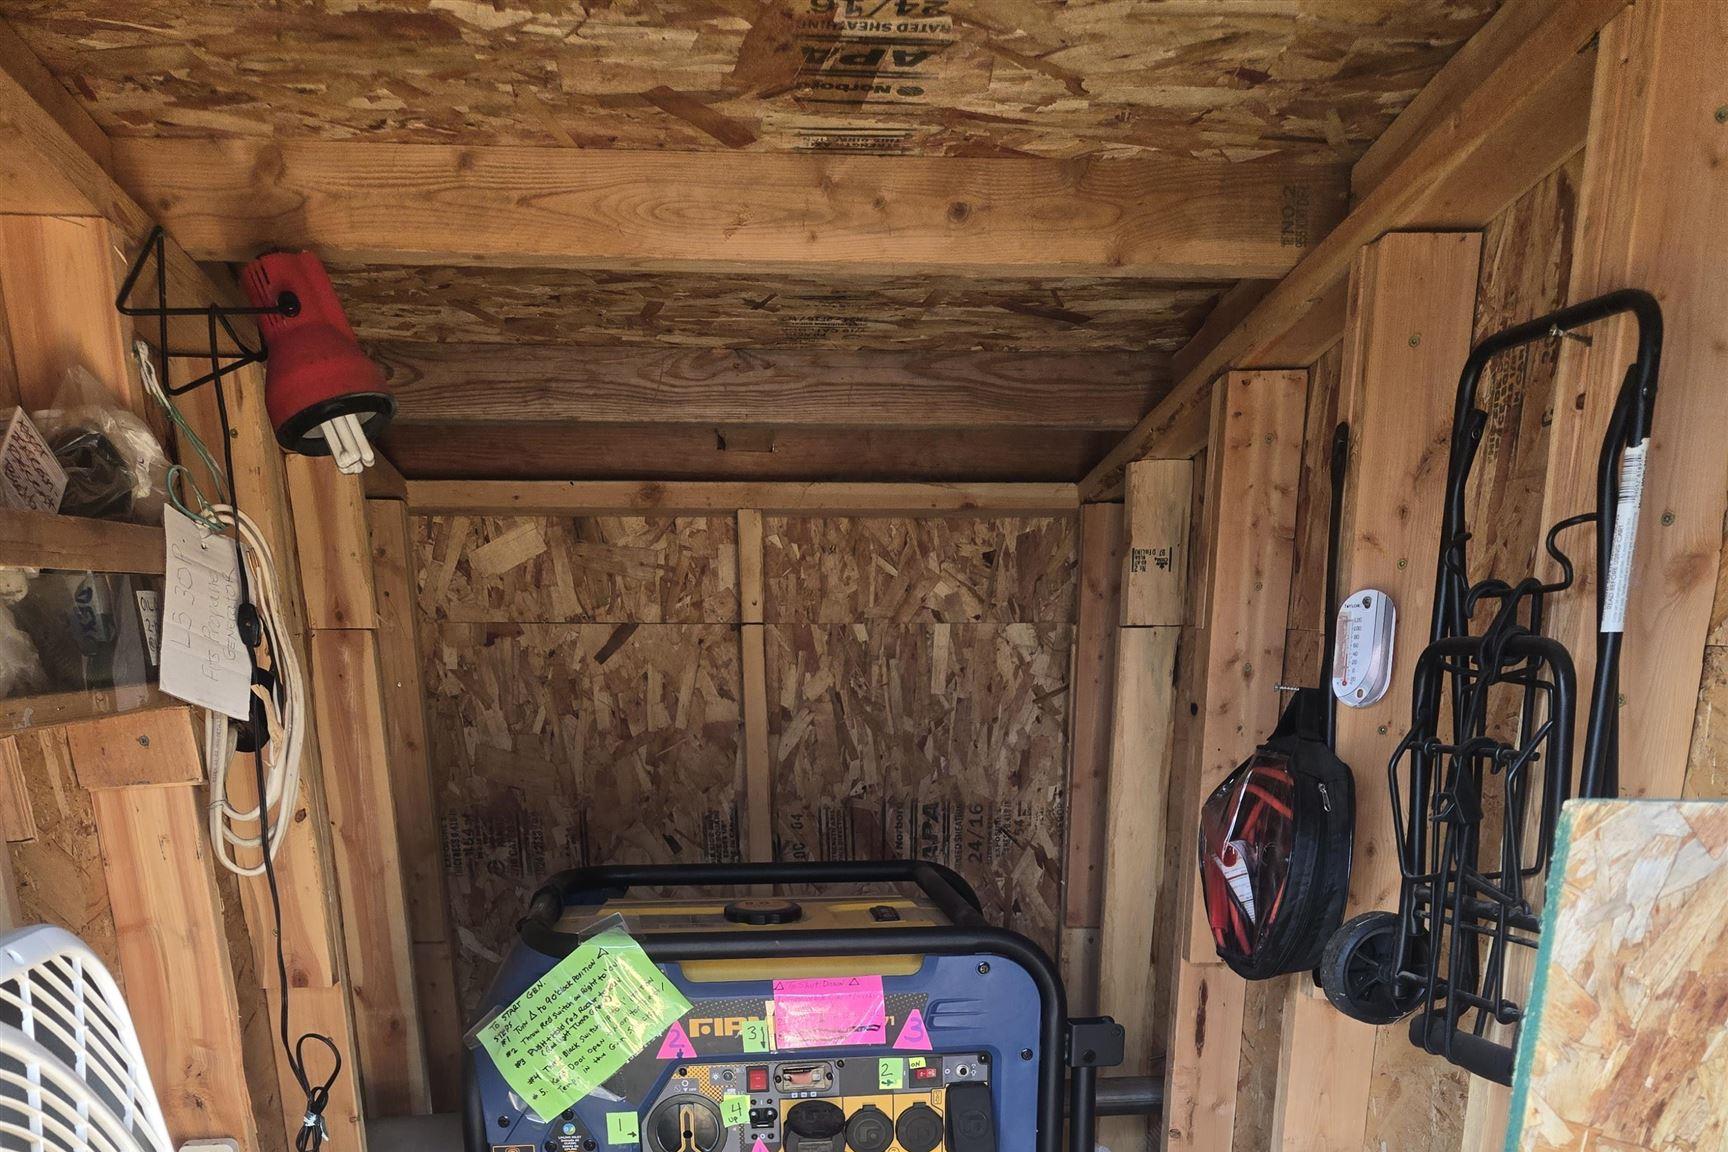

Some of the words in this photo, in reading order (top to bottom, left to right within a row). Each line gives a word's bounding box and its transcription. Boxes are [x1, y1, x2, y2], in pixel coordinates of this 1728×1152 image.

[896, 22, 951, 34] RATED
[800, 47, 932, 68] APA
[170, 611, 193, 649] L5
[921, 802, 939, 860] APA
[966, 803, 984, 864] 24/16
[501, 1001, 522, 1021] START
[688, 1016, 760, 1037] FIR
[747, 1025, 757, 1039] 3
[904, 1016, 923, 1042] 3
[665, 1029, 685, 1048] 2
[880, 1063, 893, 1077] 2
[731, 1102, 742, 1117] 4
